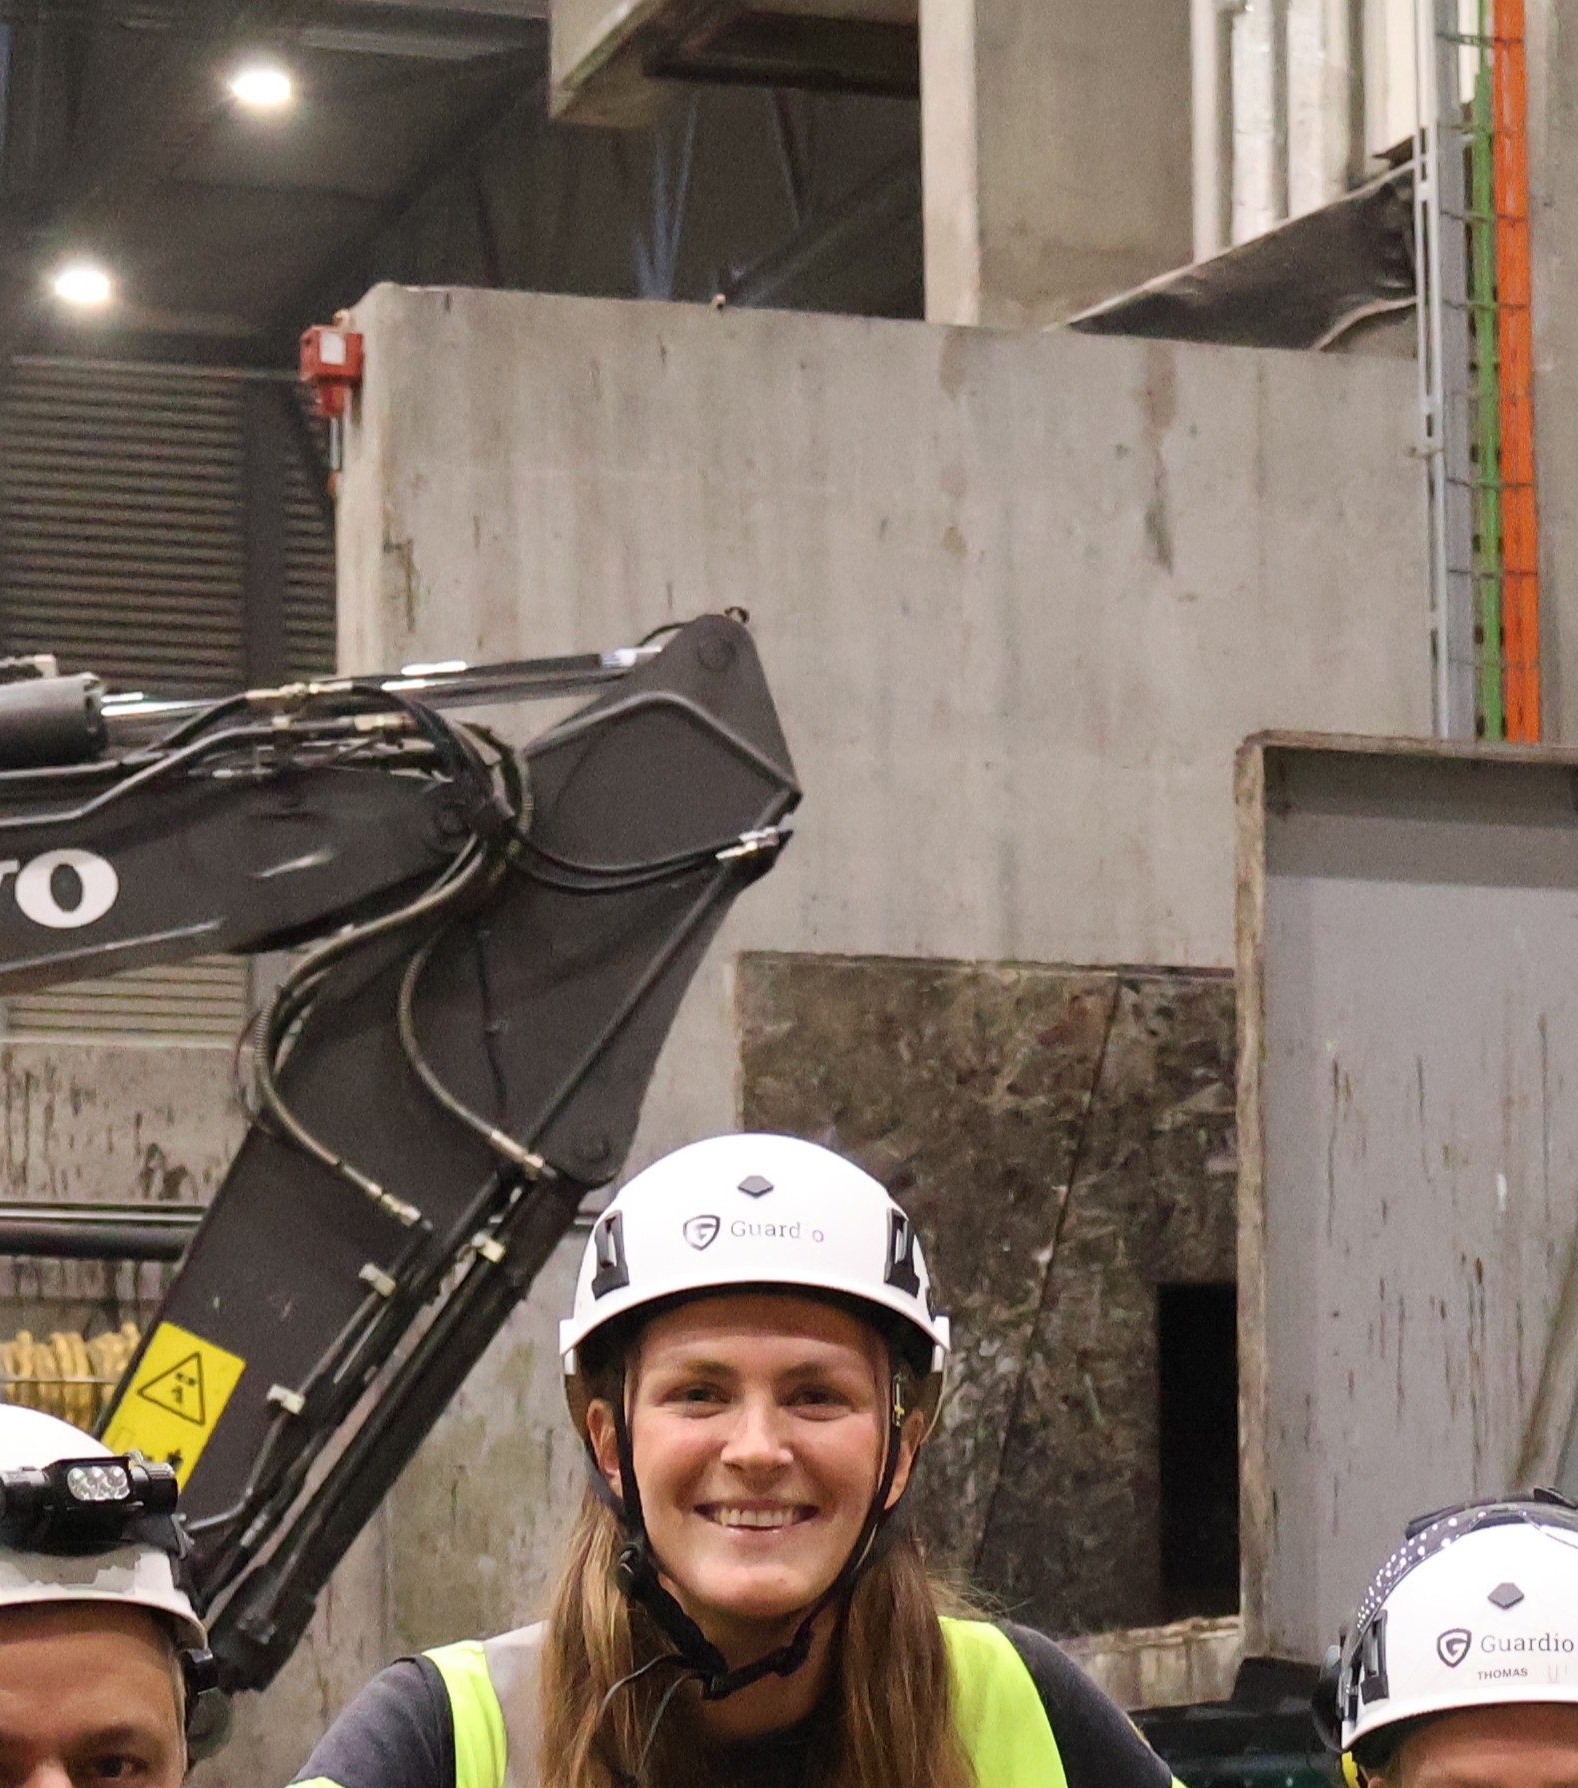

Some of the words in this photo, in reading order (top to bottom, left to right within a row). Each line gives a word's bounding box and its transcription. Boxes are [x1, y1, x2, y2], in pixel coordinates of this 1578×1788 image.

[730, 1220, 825, 1243] Guardo
[1480, 1632, 1575, 1654] Guardio
[1477, 1667, 1528, 1681] THOMAS
